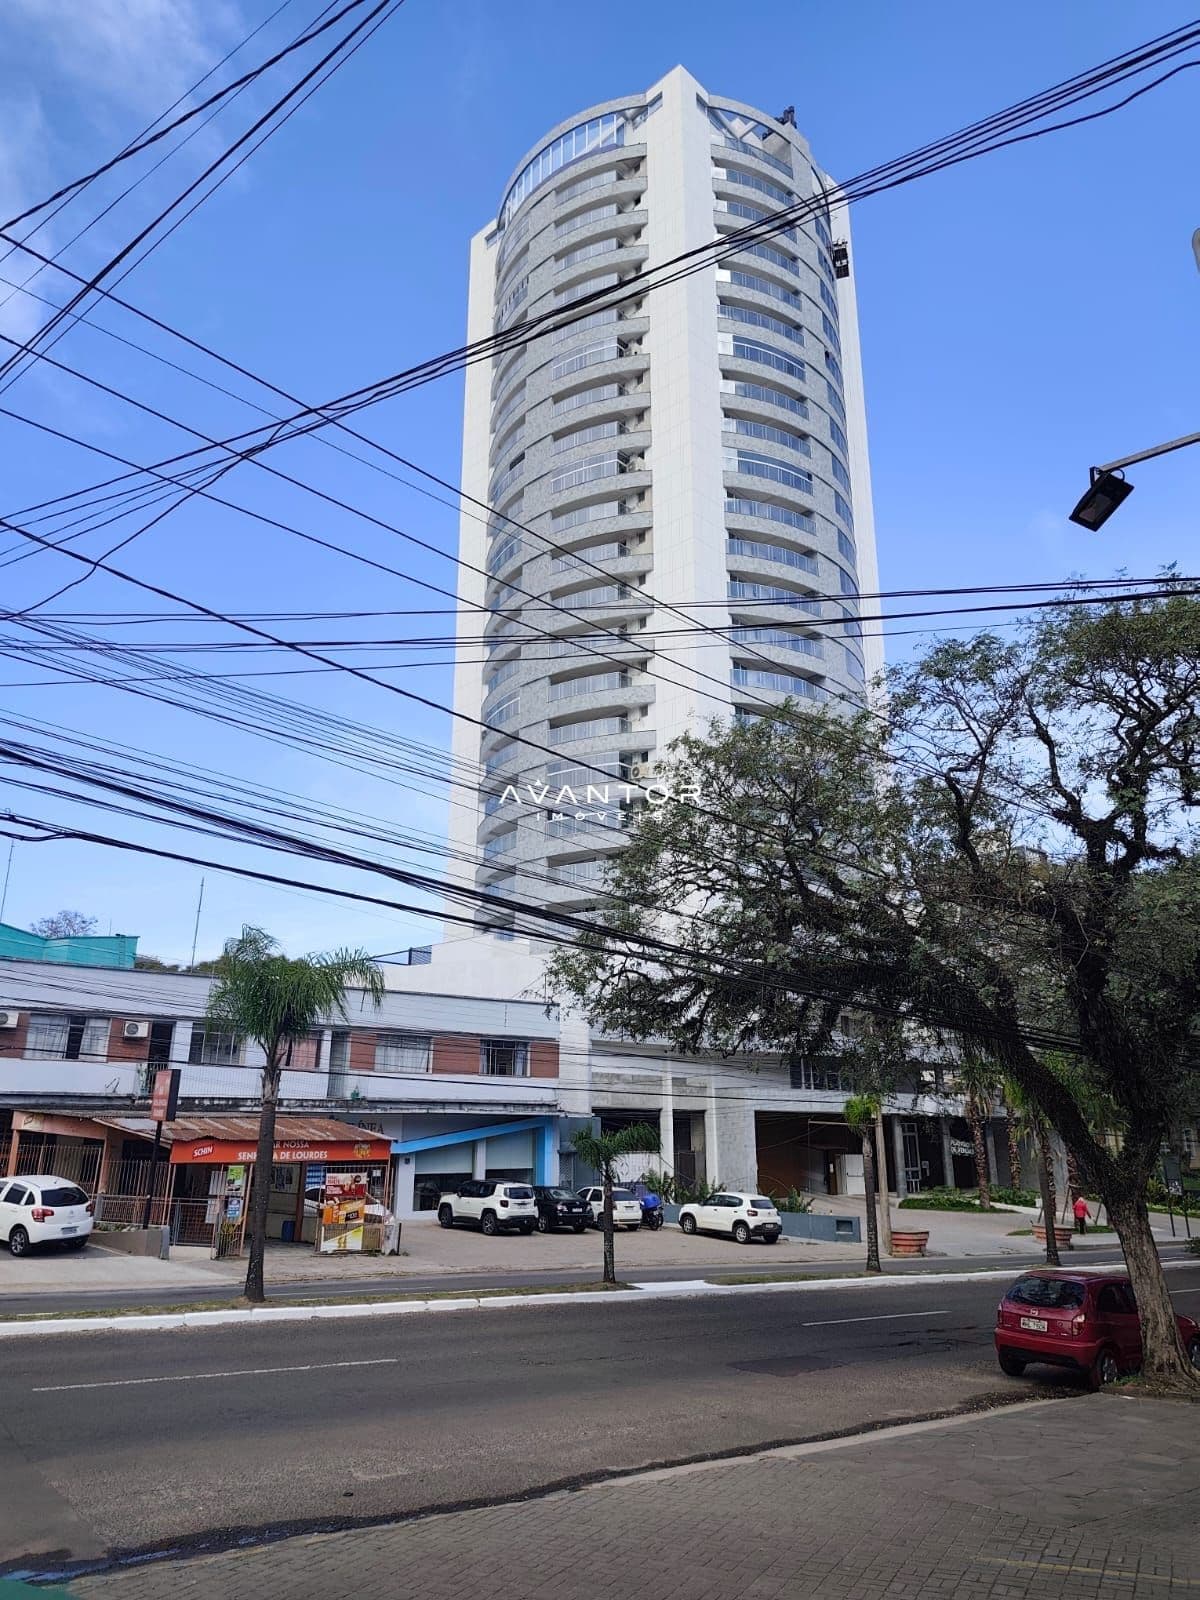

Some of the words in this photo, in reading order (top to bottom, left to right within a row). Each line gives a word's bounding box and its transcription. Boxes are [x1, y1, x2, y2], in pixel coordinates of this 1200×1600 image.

[283, 1141, 310, 1149] NOSSA
[193, 1146, 214, 1157] SCHIN
[237, 1151, 278, 1161] SENHA
[280, 1151, 290, 1160] DE
[292, 1150, 328, 1160] LOURDES
